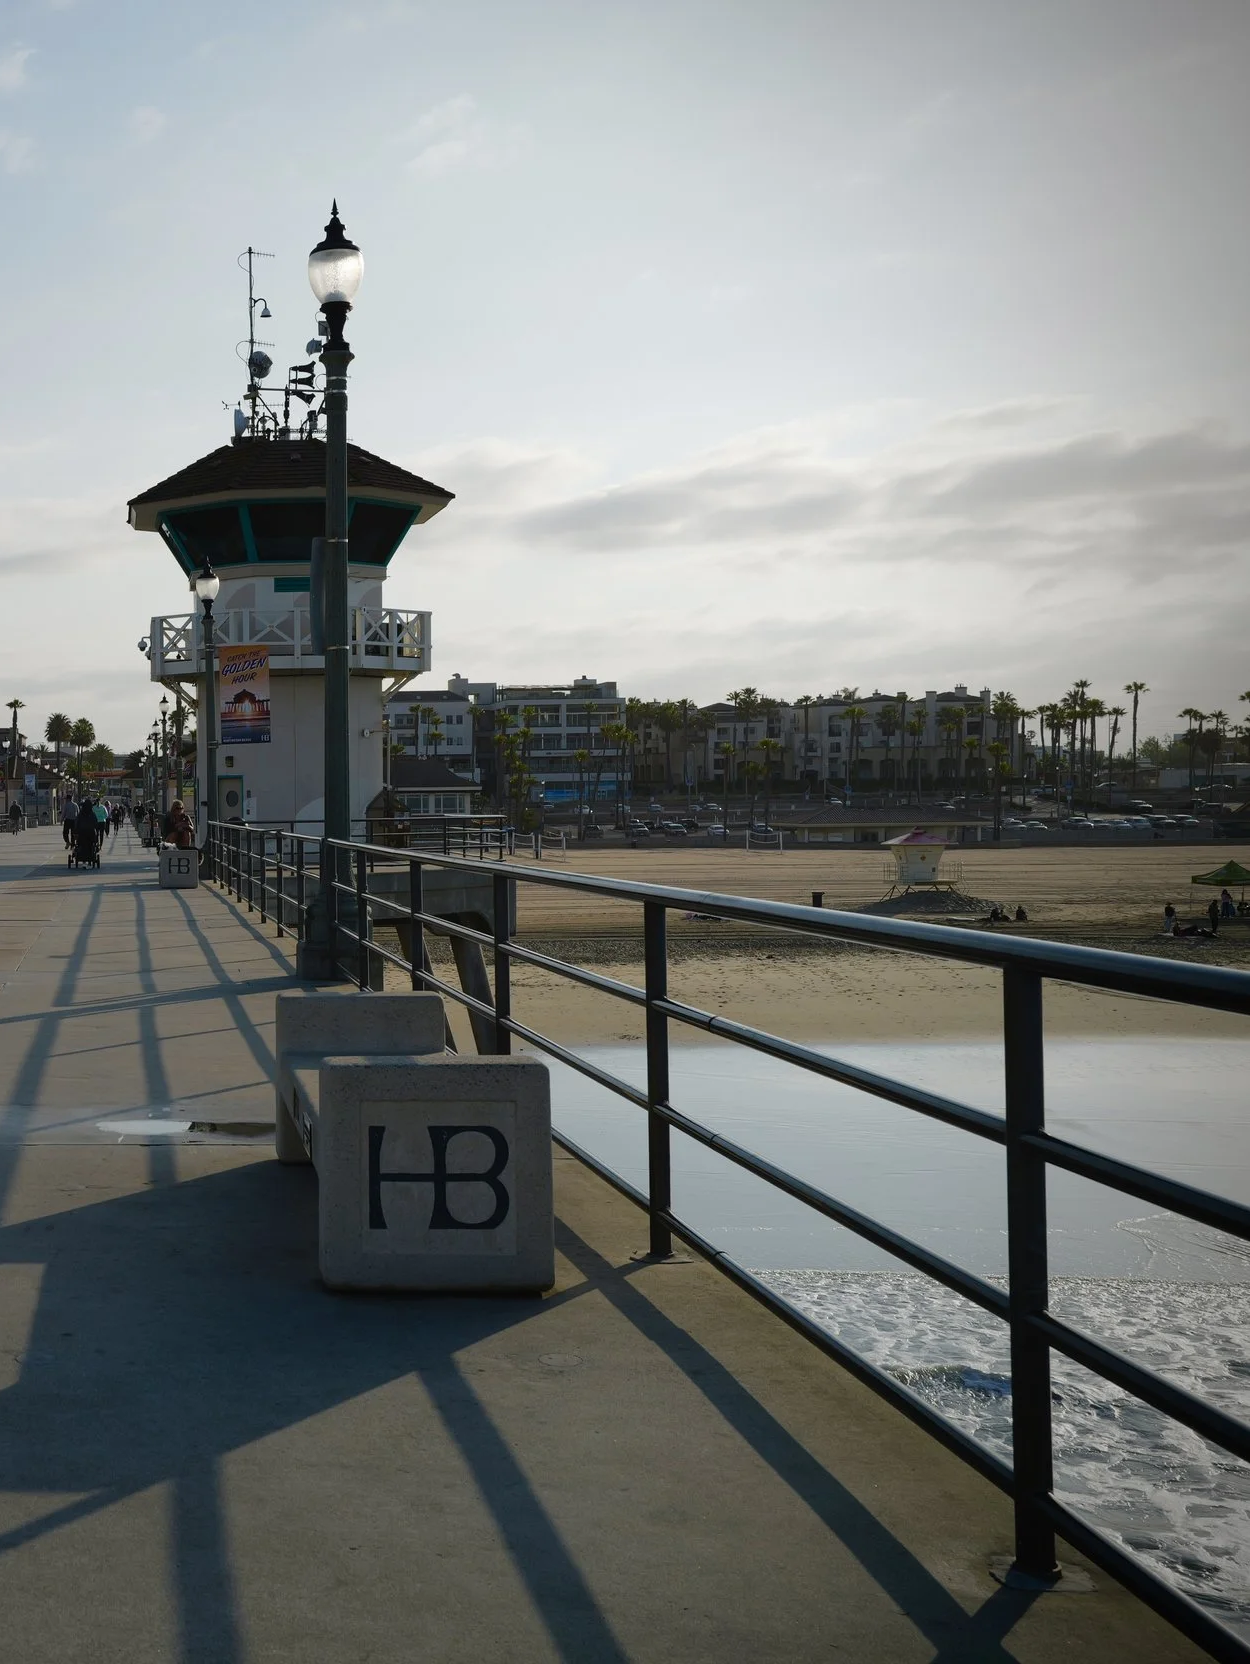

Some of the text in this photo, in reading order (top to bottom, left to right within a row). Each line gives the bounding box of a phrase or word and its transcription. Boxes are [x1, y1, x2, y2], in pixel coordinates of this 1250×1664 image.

[222, 656, 266, 676] GOLDEN
[231, 672, 257, 685] HOUR
[169, 857, 190, 874] HB
[368, 1125, 510, 1230] HB
